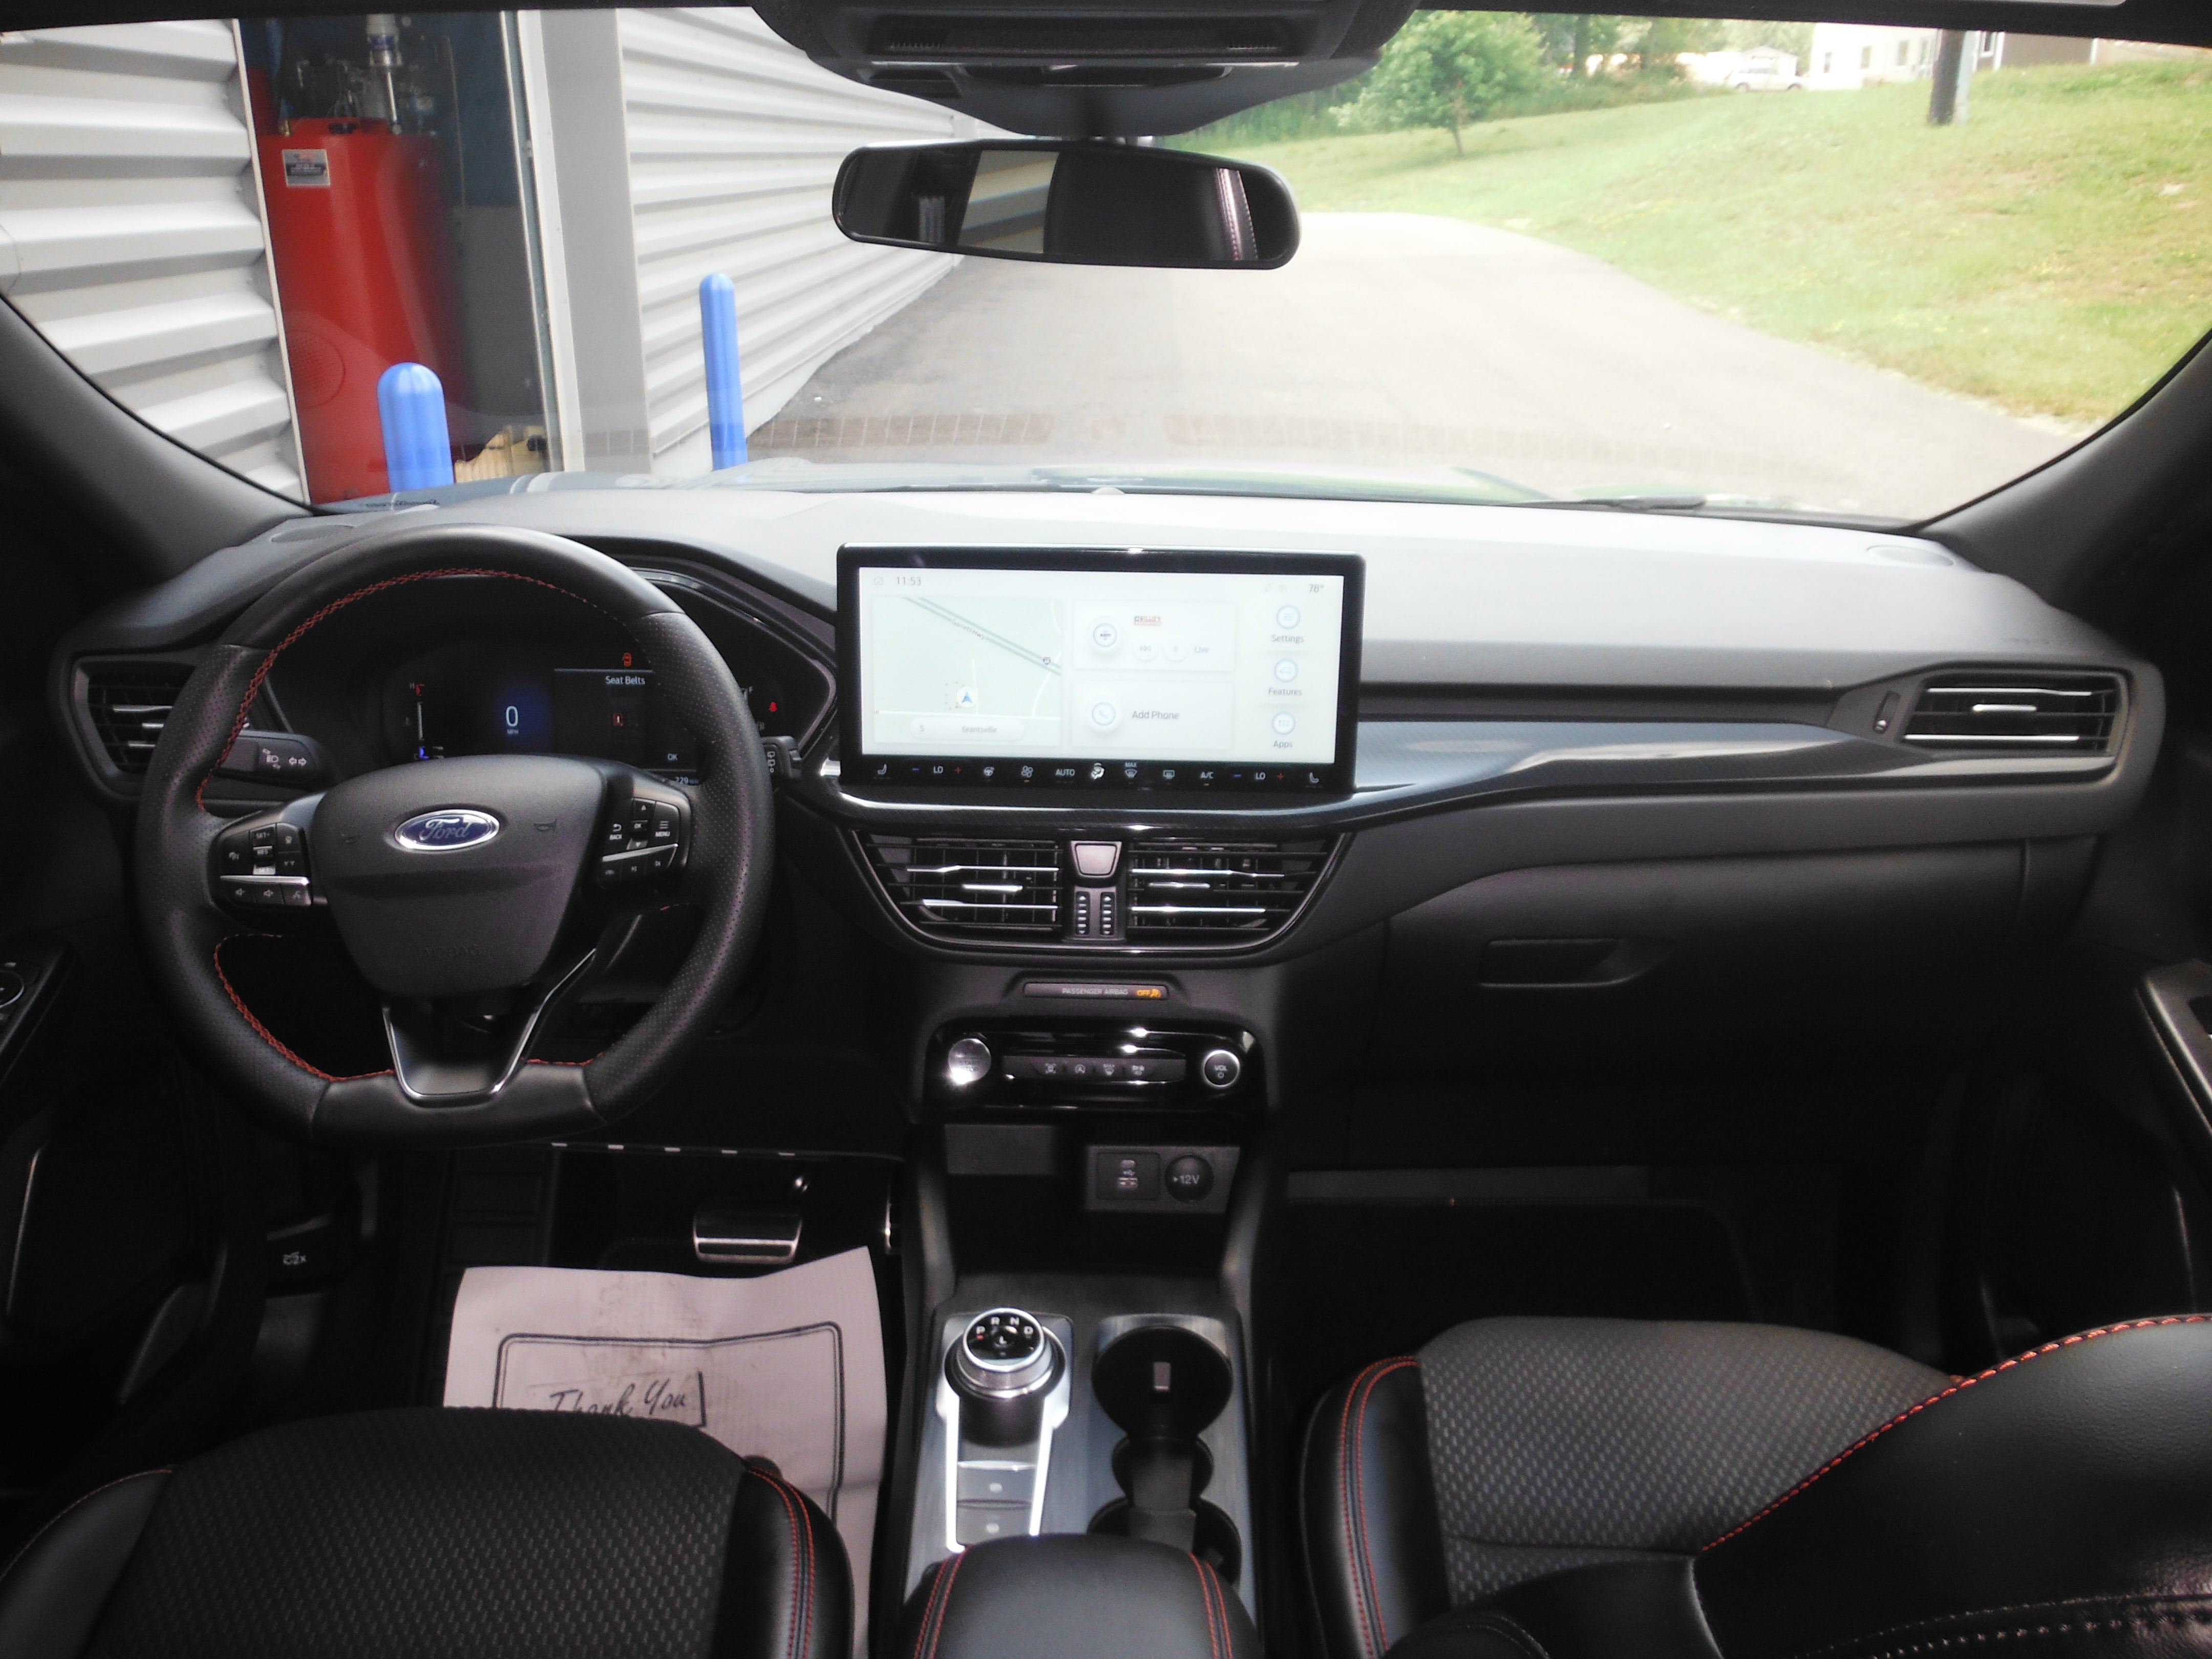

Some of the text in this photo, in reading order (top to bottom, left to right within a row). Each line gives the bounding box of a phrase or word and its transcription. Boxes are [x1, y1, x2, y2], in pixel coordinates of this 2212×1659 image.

[897, 577, 921, 585] 11:53
[1271, 634, 1304, 644] Settings
[1195, 645, 1209, 653] Live
[605, 675, 646, 685] Seat Belts
[1132, 711, 1179, 719] Add Phone
[962, 725, 997, 734] Grantsville
[1273, 740, 1293, 749] Apps
[419, 818, 472, 841] Ford
[991, 1316, 1001, 1325] R
[1010, 1316, 1019, 1325] N
[976, 1326, 986, 1334] P
[1023, 1326, 1034, 1334] D
[999, 1335, 1007, 1345] L
[550, 1378, 685, 1416] Thank You
